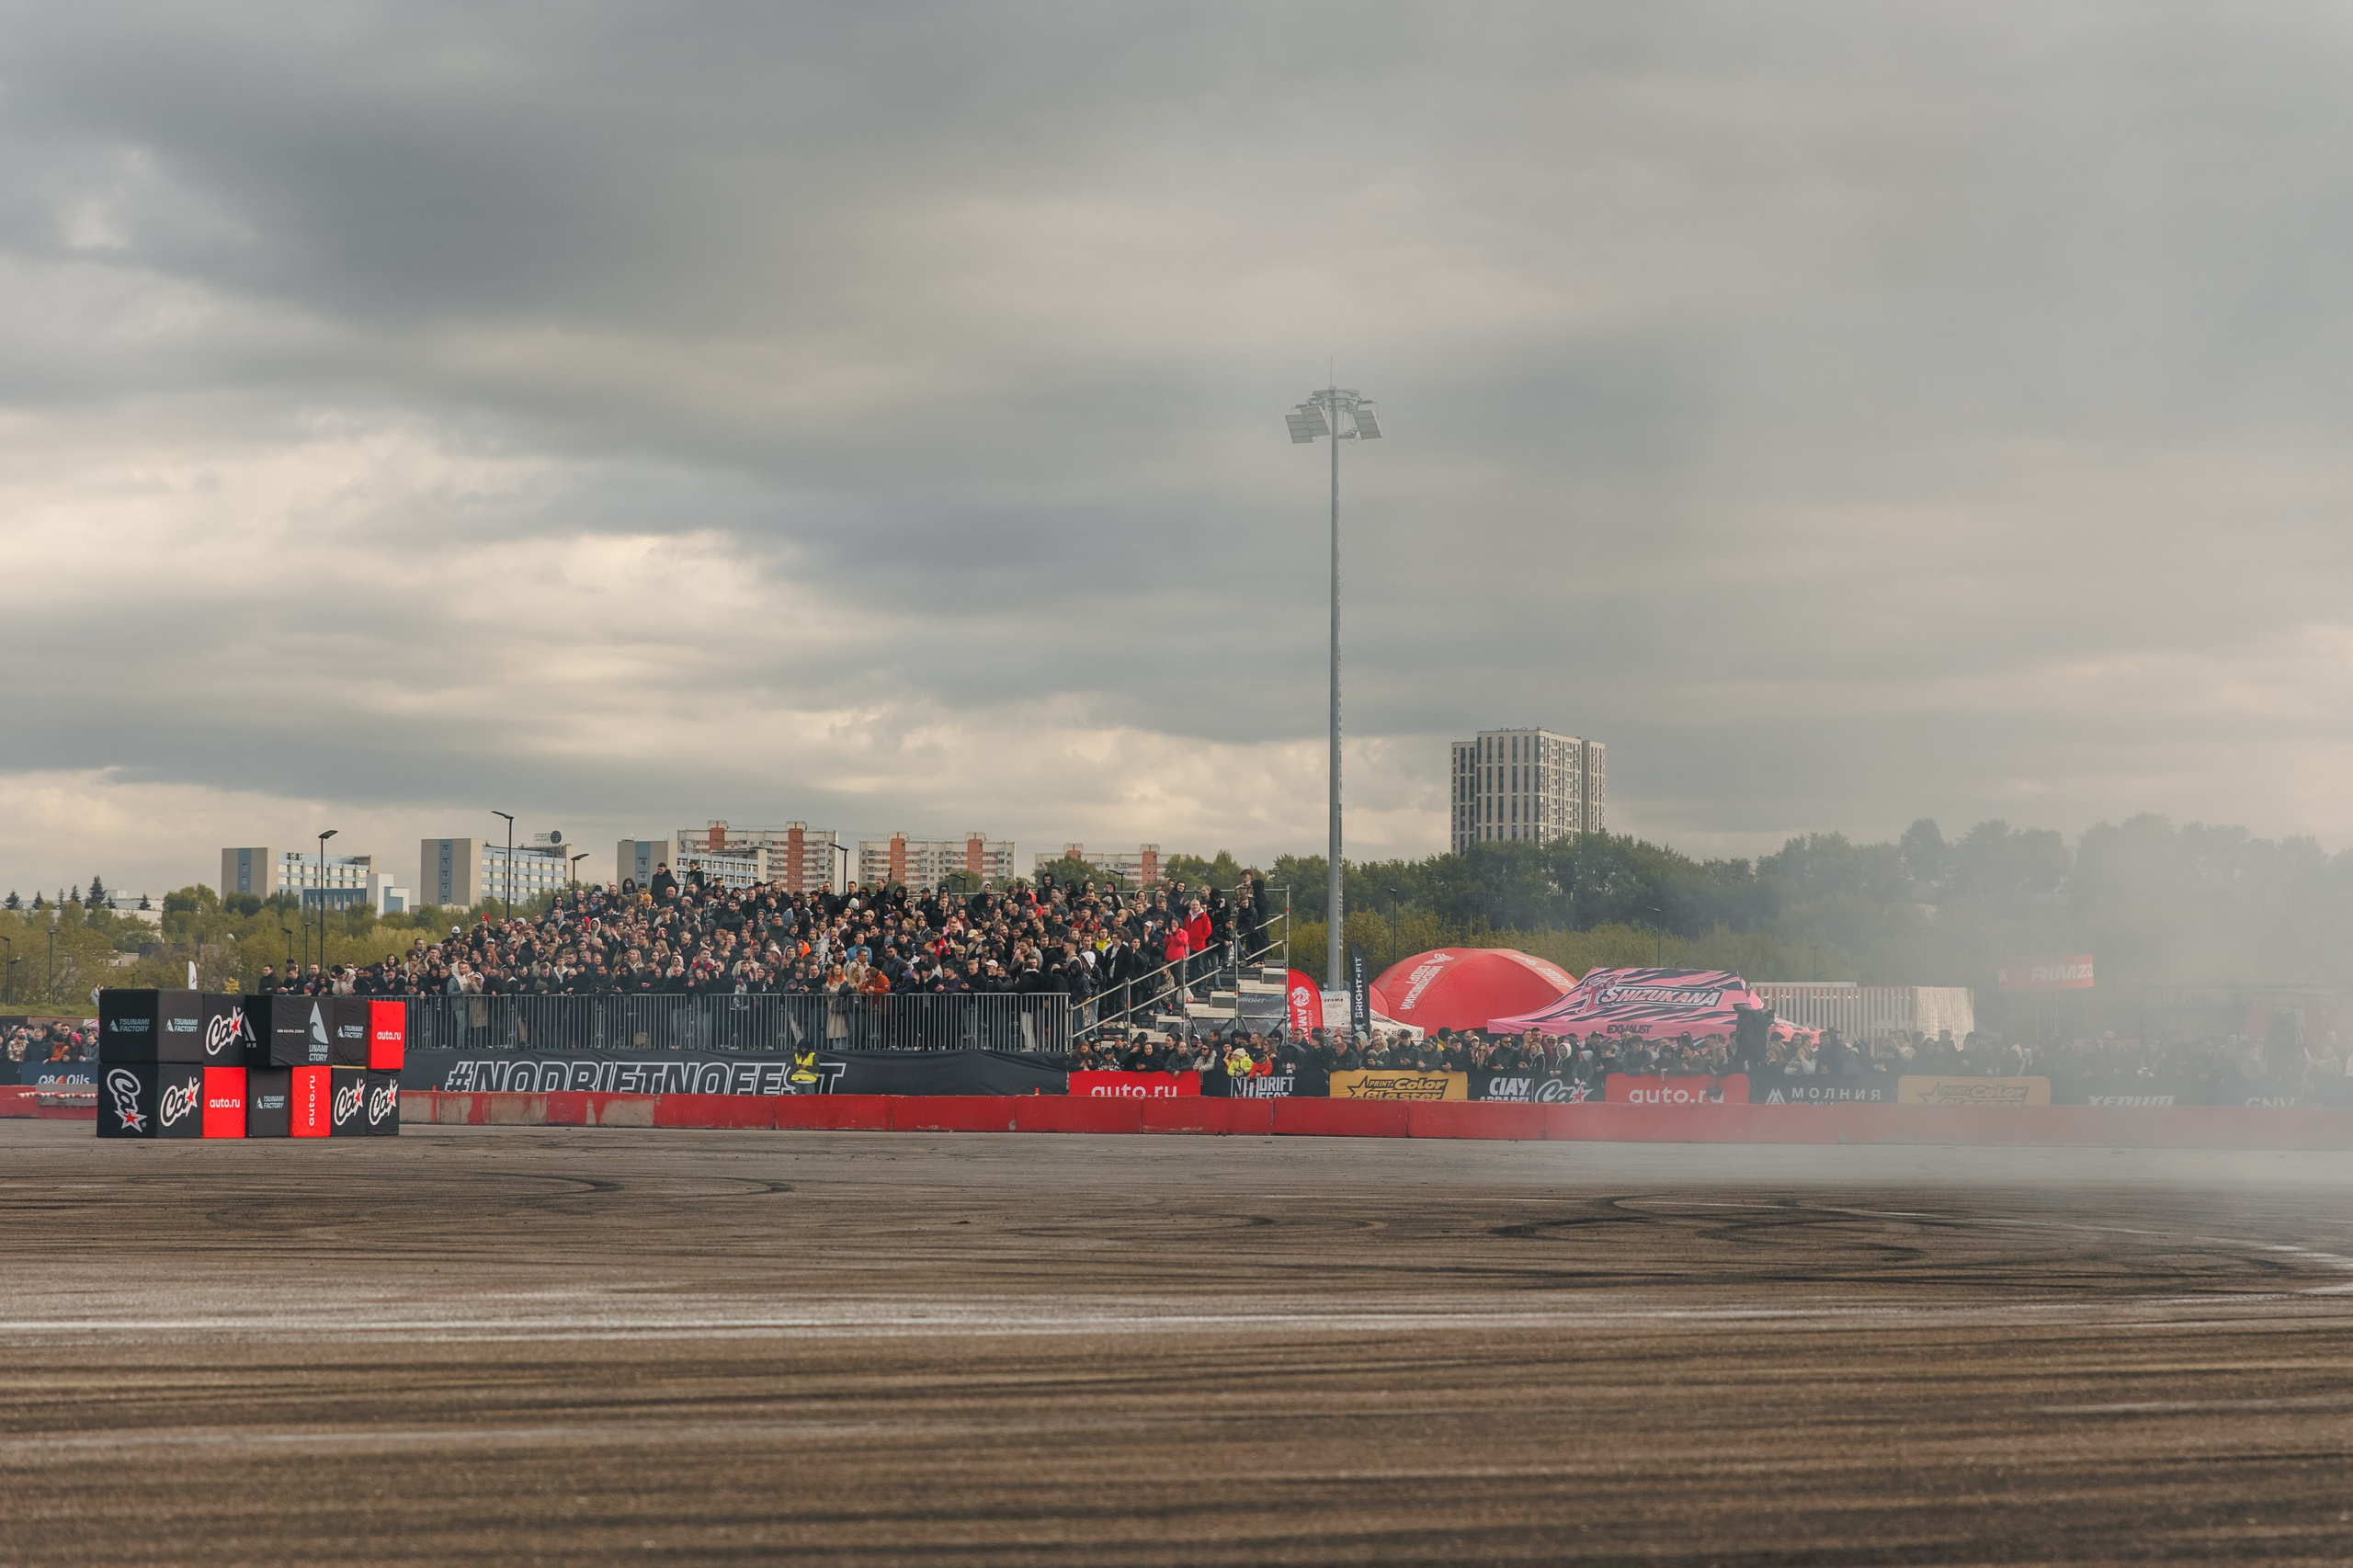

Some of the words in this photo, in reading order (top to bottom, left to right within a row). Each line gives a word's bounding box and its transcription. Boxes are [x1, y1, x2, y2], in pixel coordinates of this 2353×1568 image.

[1405, 965, 1431, 984] СПОРТ
[1602, 988, 1720, 1006] SHIZUKANA
[174, 1017, 199, 1026] TSUNAMI
[1607, 1024, 1653, 1034] EXHAUST
[377, 1031, 402, 1040] auto.ru
[309, 1044, 328, 1052] UNAMI
[309, 1052, 328, 1062] CTORY
[66, 1074, 90, 1084] Oils
[1259, 1076, 1295, 1092] DRIFT
[1393, 1077, 1446, 1090] Color
[1090, 1084, 1177, 1097] auto.ru
[1629, 1086, 1724, 1103] auto.ru
[1792, 1087, 1881, 1100] МОЛНИЯ
[1969, 1085, 2026, 1097] Color
[210, 1098, 241, 1108] auto.ru
